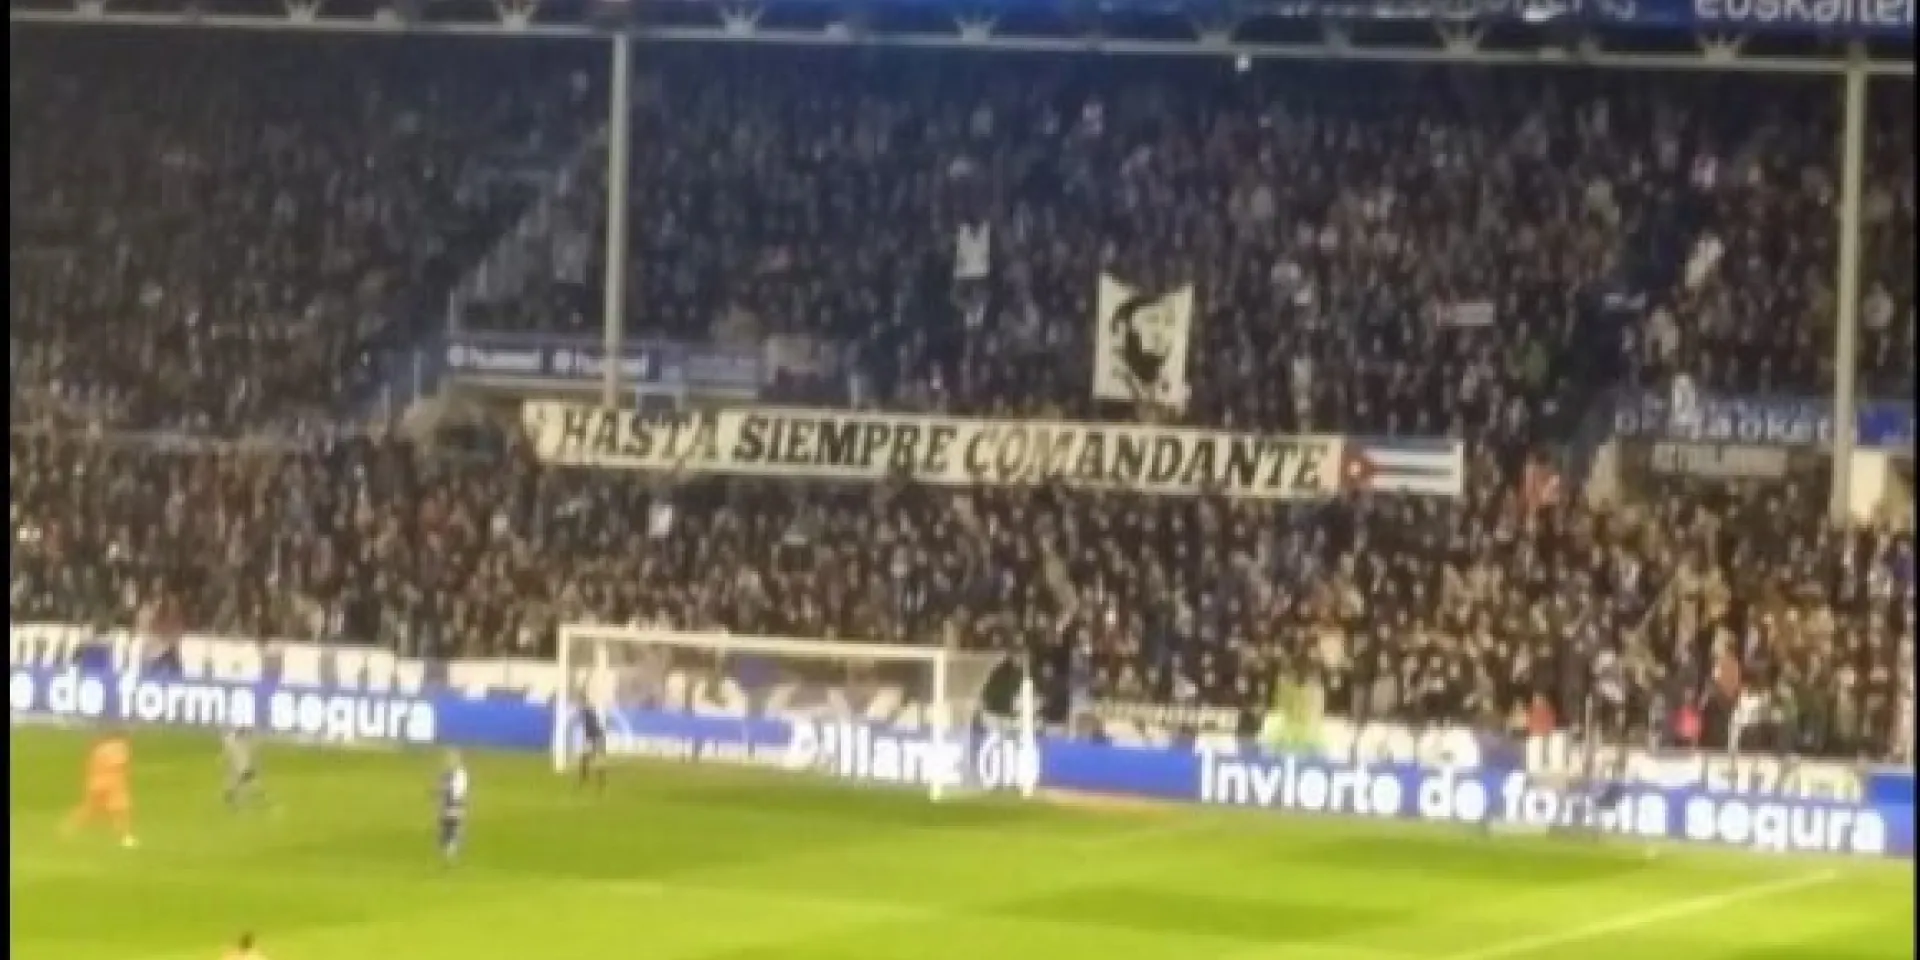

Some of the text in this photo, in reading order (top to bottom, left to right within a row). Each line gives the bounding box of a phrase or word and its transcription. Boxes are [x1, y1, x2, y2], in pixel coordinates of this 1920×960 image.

[562, 405, 1330, 495] HASTA SIEMPRE COMANDANTE
[49, 665, 106, 713] de
[119, 669, 255, 728] forma
[270, 689, 437, 744] segura
[1199, 742, 1402, 815] Invierte
[1418, 763, 1487, 821] de
[1685, 797, 1887, 853] segura
